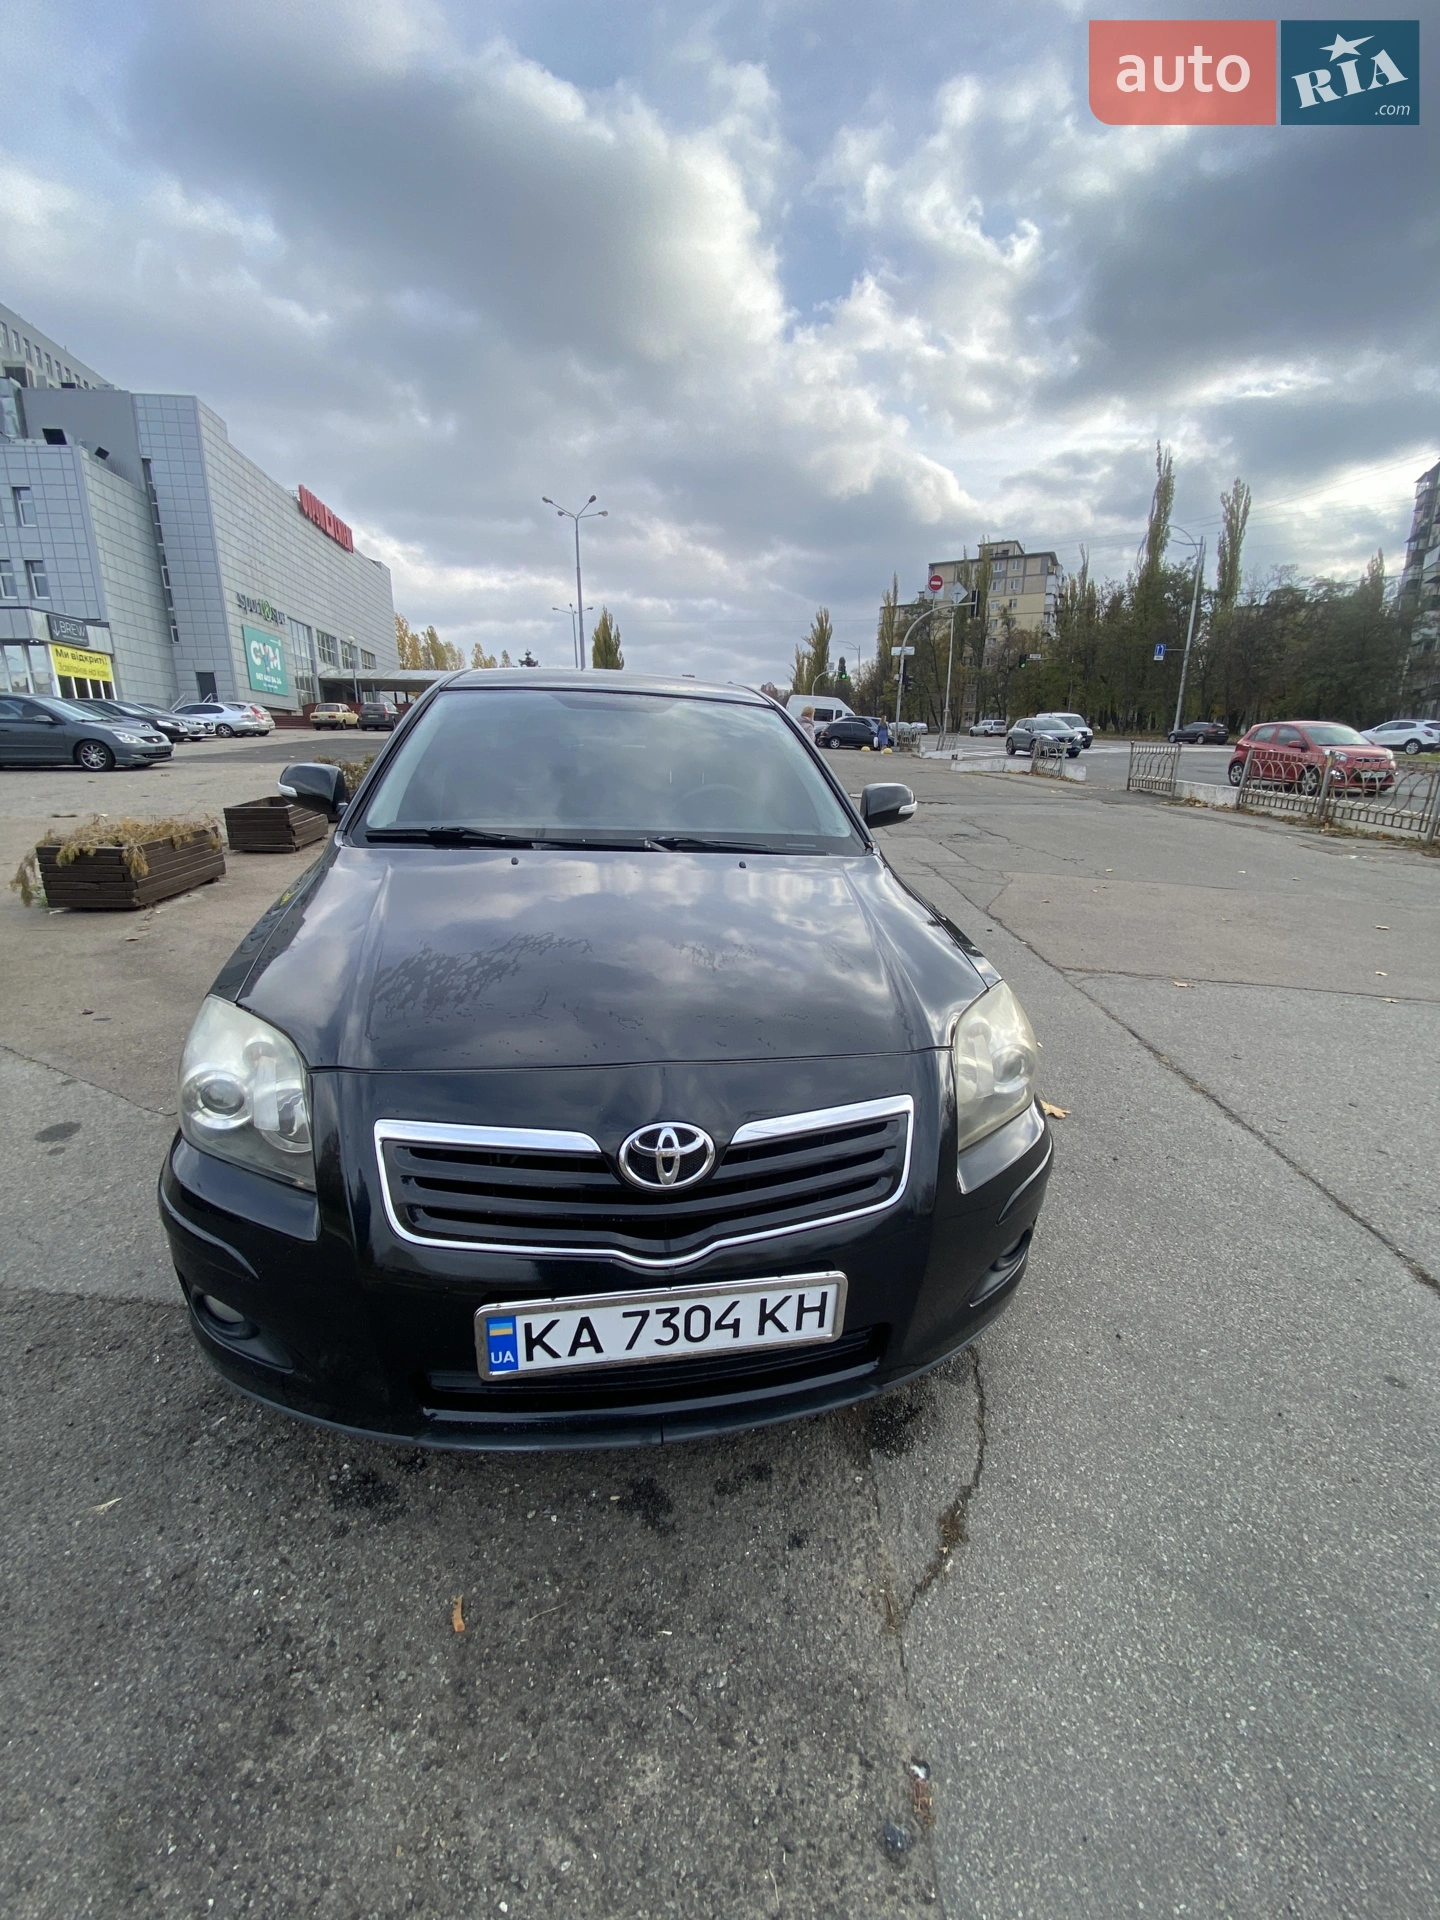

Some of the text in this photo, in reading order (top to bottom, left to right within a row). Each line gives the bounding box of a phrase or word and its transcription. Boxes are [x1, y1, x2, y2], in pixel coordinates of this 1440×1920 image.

[60, 620, 86, 636] BREW
[55, 648, 69, 659] Ми
[523, 1291, 828, 1362] KA 7304 KH
[491, 1351, 515, 1365] UA
